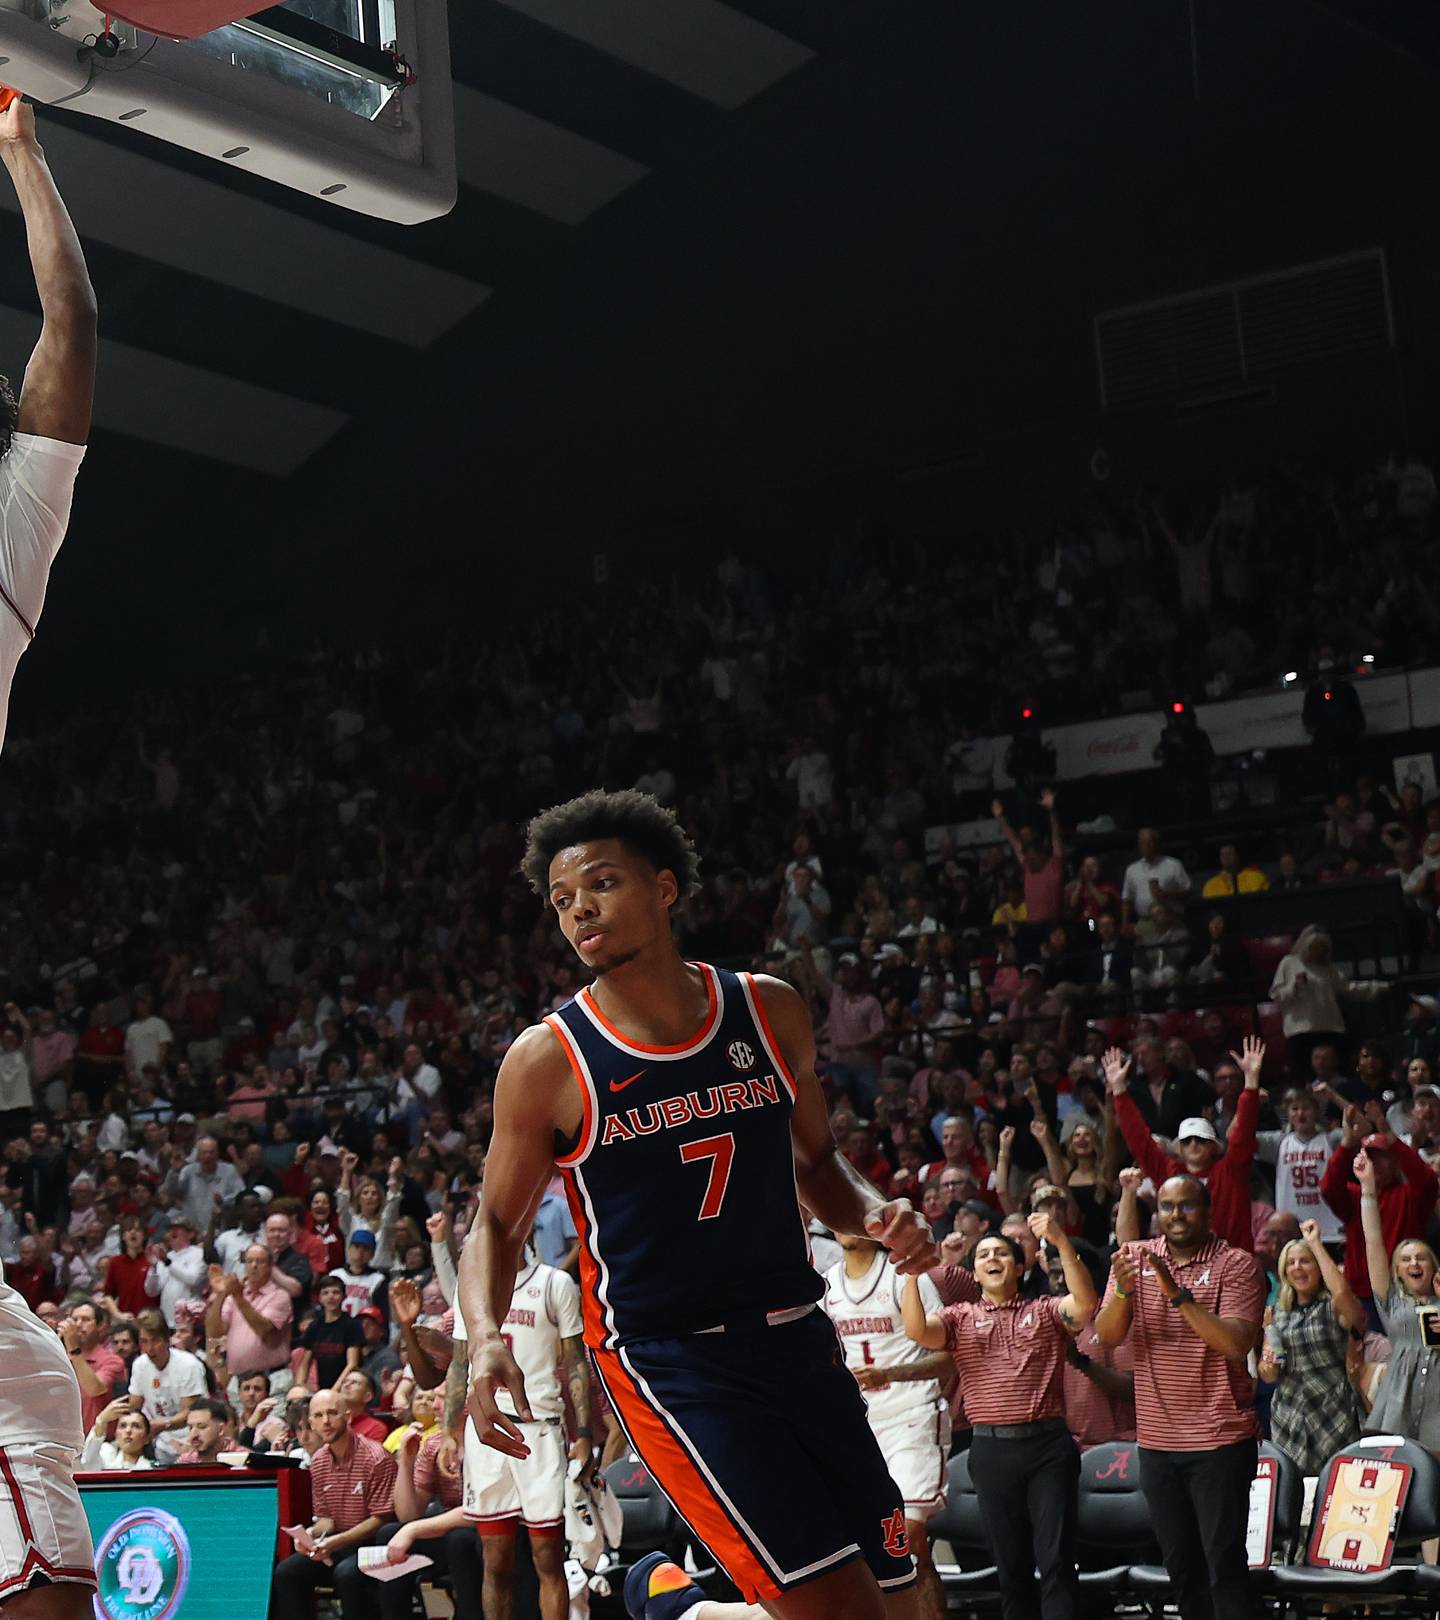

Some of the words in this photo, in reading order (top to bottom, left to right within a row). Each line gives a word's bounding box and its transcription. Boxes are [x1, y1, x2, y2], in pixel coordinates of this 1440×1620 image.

[728, 1041, 755, 1068] SEC
[601, 1075, 780, 1145] AUBURN
[679, 1132, 736, 1221] 7
[1291, 1165, 1320, 1189] 95
[837, 1316, 894, 1336] RIMSON
[861, 1339, 875, 1365] 1
